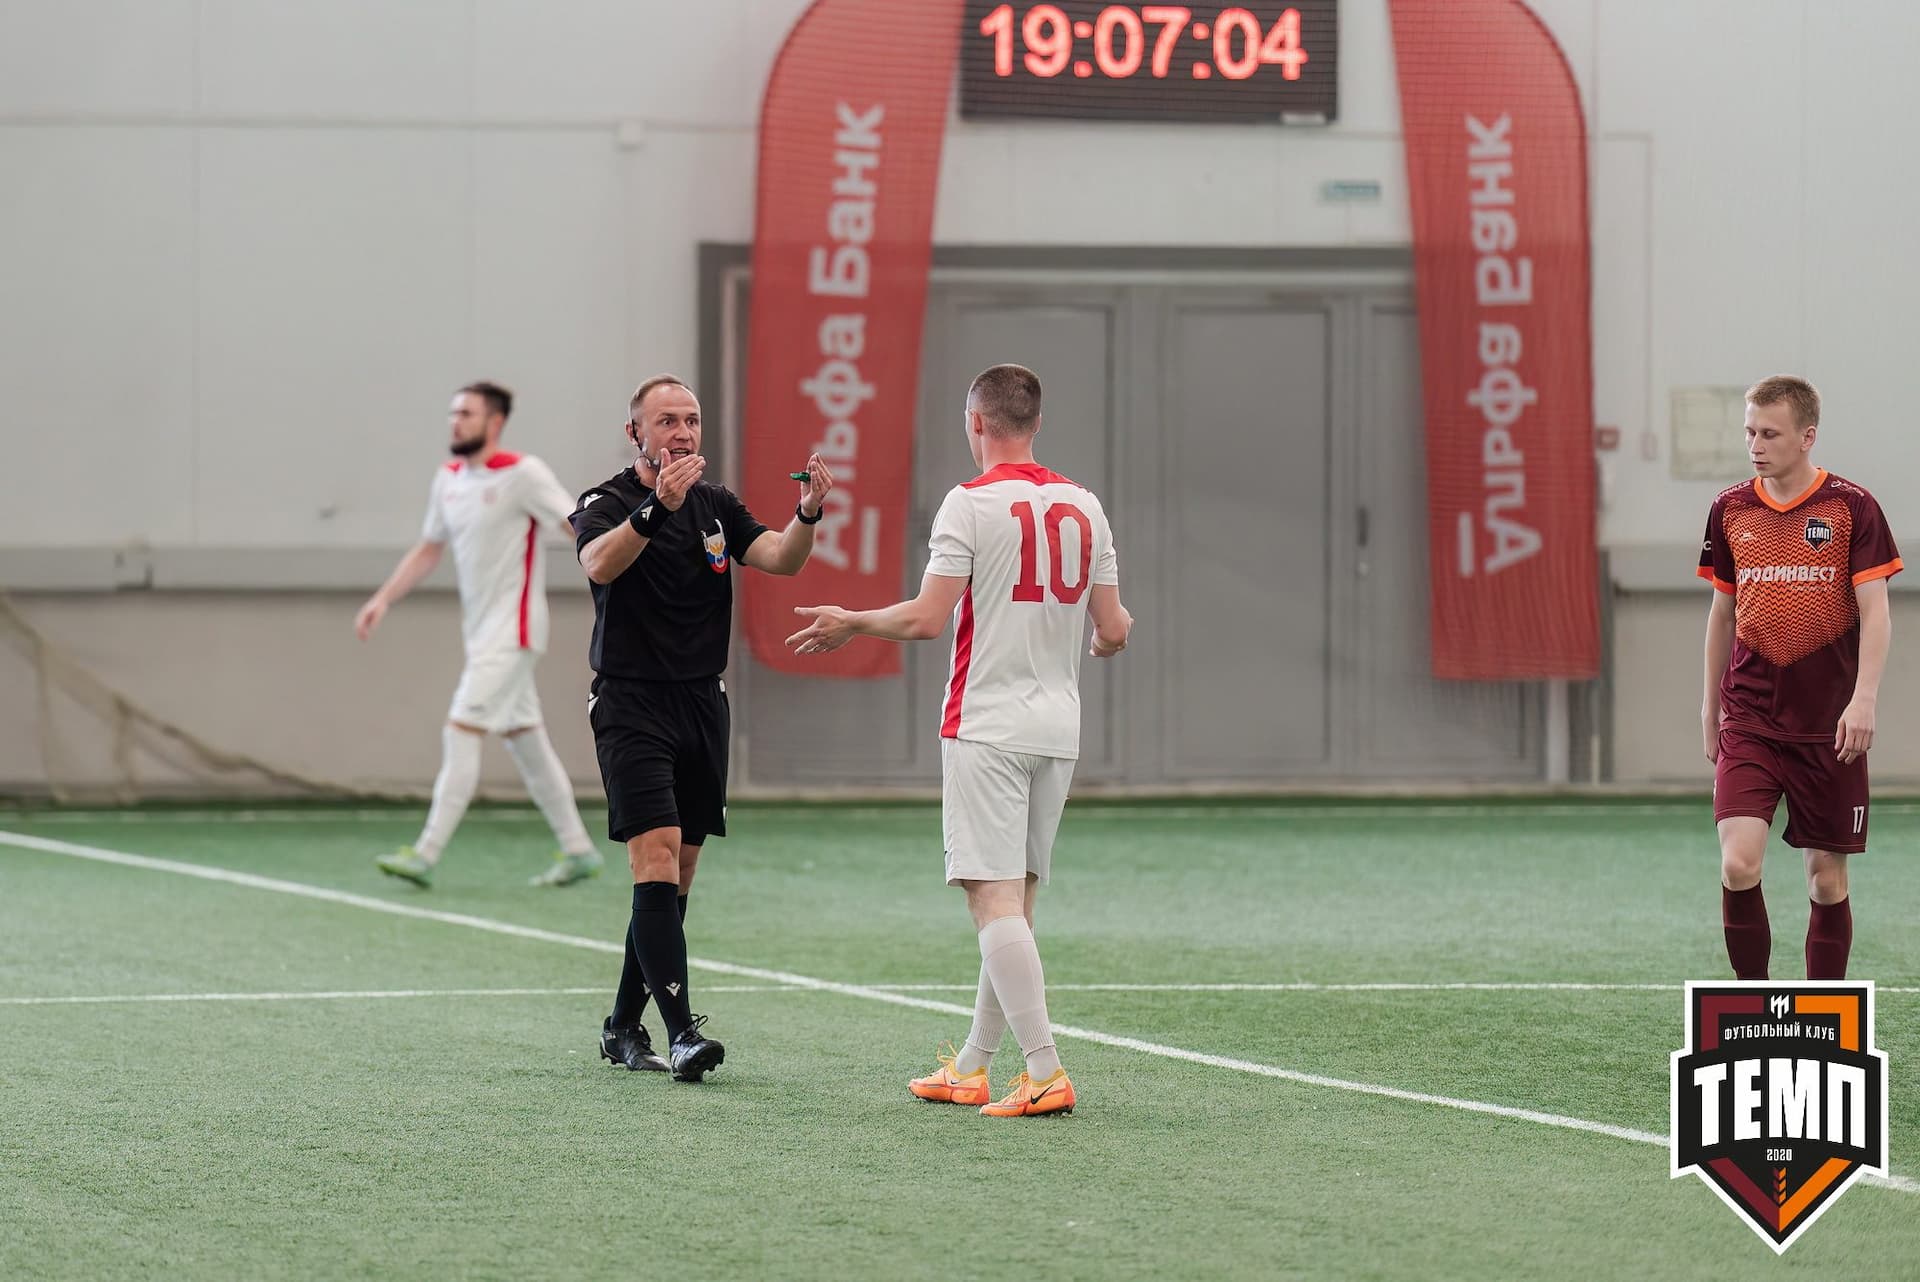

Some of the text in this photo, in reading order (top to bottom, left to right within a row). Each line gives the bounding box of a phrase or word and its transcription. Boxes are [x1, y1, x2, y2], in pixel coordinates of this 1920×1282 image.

[979, 3, 1309, 81] 19:07:04
[809, 103, 886, 297] Банк
[1009, 500, 1093, 605] 10
[1807, 526, 1831, 541] ТЕМП
[1852, 805, 1865, 834] 17
